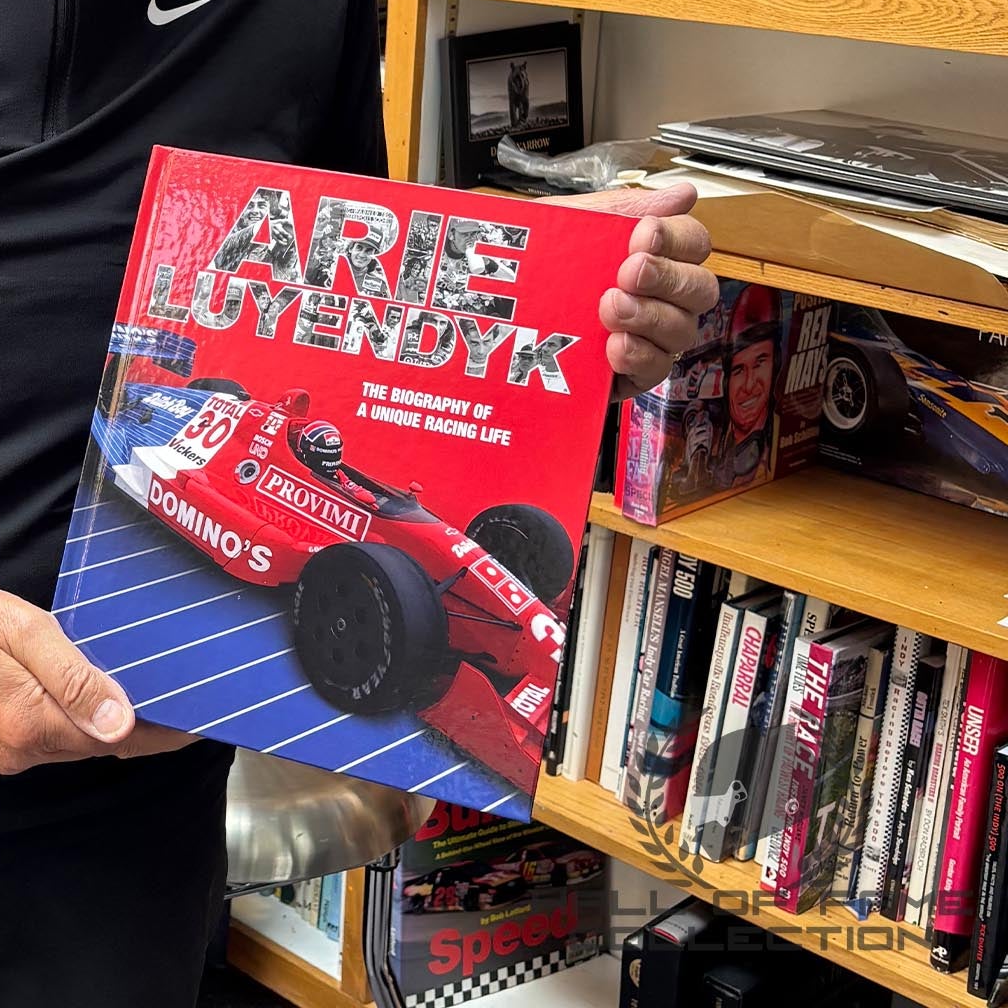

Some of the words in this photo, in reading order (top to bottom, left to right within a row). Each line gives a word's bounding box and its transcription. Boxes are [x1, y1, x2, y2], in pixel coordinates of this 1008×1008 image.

[208, 185, 530, 322] ARIE
[147, 263, 582, 394] LUYENDYK
[796, 305, 832, 353] REX
[784, 344, 830, 395] MAYS
[207, 396, 244, 420] TOTAL
[362, 381, 389, 401] THE
[390, 387, 472, 417] BIOGRAPHY
[473, 403, 494, 420] OF
[184, 410, 231, 449] 30
[356, 402, 367, 418] A
[370, 404, 423, 429] UNIQUE
[424, 415, 477, 440] RACING
[480, 426, 512, 446] LIFE
[168, 438, 207, 466] Vickers
[264, 472, 363, 535] PROVIMI
[150, 479, 273, 573] DOMINO'S
[673, 570, 697, 600] 500
[649, 579, 667, 643] MANSELL'S
[644, 644, 656, 668] Indy
[710, 611, 733, 679] Indianapolis
[897, 636, 908, 667] INDY
[732, 626, 763, 708] CHAPARRAL
[794, 652, 809, 671] TIME
[643, 668, 653, 686] Car
[792, 671, 806, 694] FLIES
[801, 657, 828, 707] THE
[510, 683, 551, 718] TOTAL
[636, 687, 650, 722] Racing
[887, 688, 900, 736] Racing
[791, 709, 821, 778] RACE
[961, 704, 984, 755] UNSER
[852, 736, 867, 770] Power
[879, 740, 892, 785] Before
[907, 759, 915, 767] by
[963, 757, 971, 767] An
[850, 775, 860, 786] to
[905, 767, 914, 782] Ken
[959, 766, 970, 795] American
[995, 763, 1006, 779] 500
[996, 779, 1004, 792] ON
[844, 790, 860, 828] Return
[875, 791, 884, 814] The
[900, 782, 912, 812] Schrader
[954, 795, 966, 816] Family
[992, 793, 1003, 812] (THE
[922, 818, 931, 834] DON
[924, 808, 932, 817] BY
[952, 816, 962, 839] Portrait
[989, 812, 1000, 835] INDY)
[781, 832, 792, 857] INDY
[870, 820, 879, 842] 500
[986, 835, 997, 851] 500
[778, 857, 788, 877] 500
[427, 890, 578, 977] Speed
